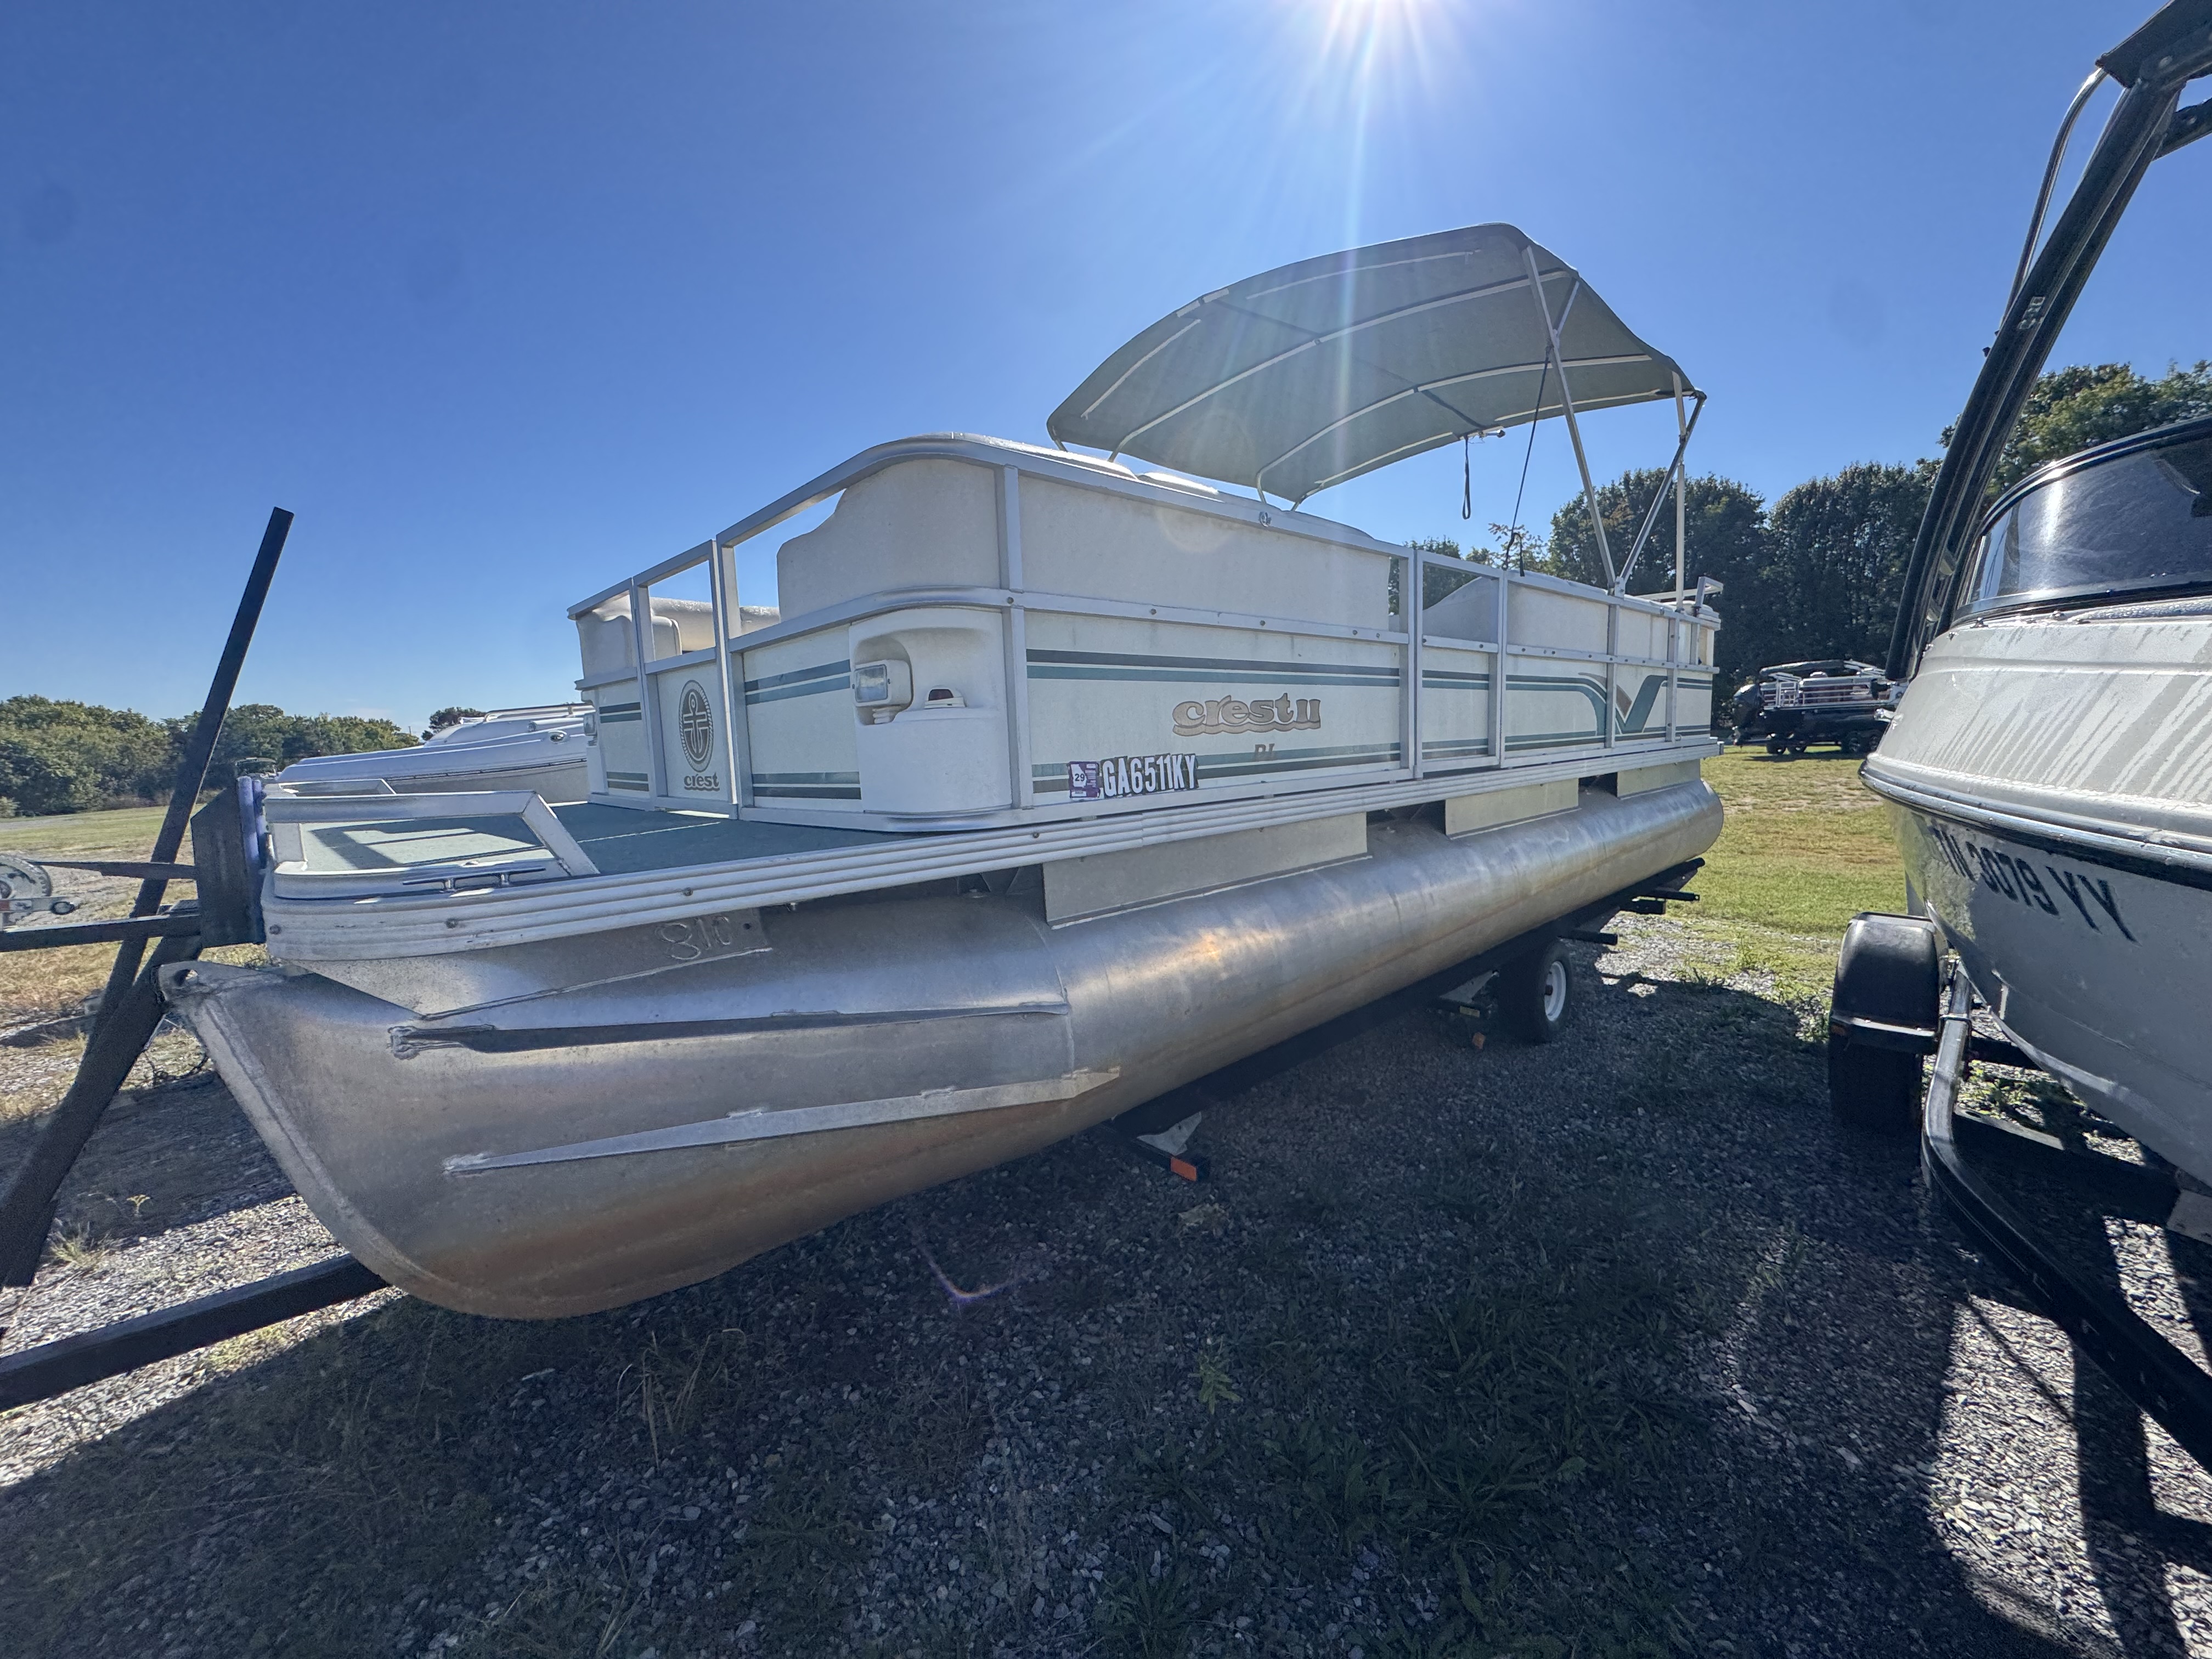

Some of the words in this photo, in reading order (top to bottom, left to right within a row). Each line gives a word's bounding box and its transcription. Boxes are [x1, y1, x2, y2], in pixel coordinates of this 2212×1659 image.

[1172, 693, 1294, 727] crest
[684, 772, 719, 787] crest
[1965, 840, 2058, 918] 3079
[2046, 866, 2141, 946] YY
